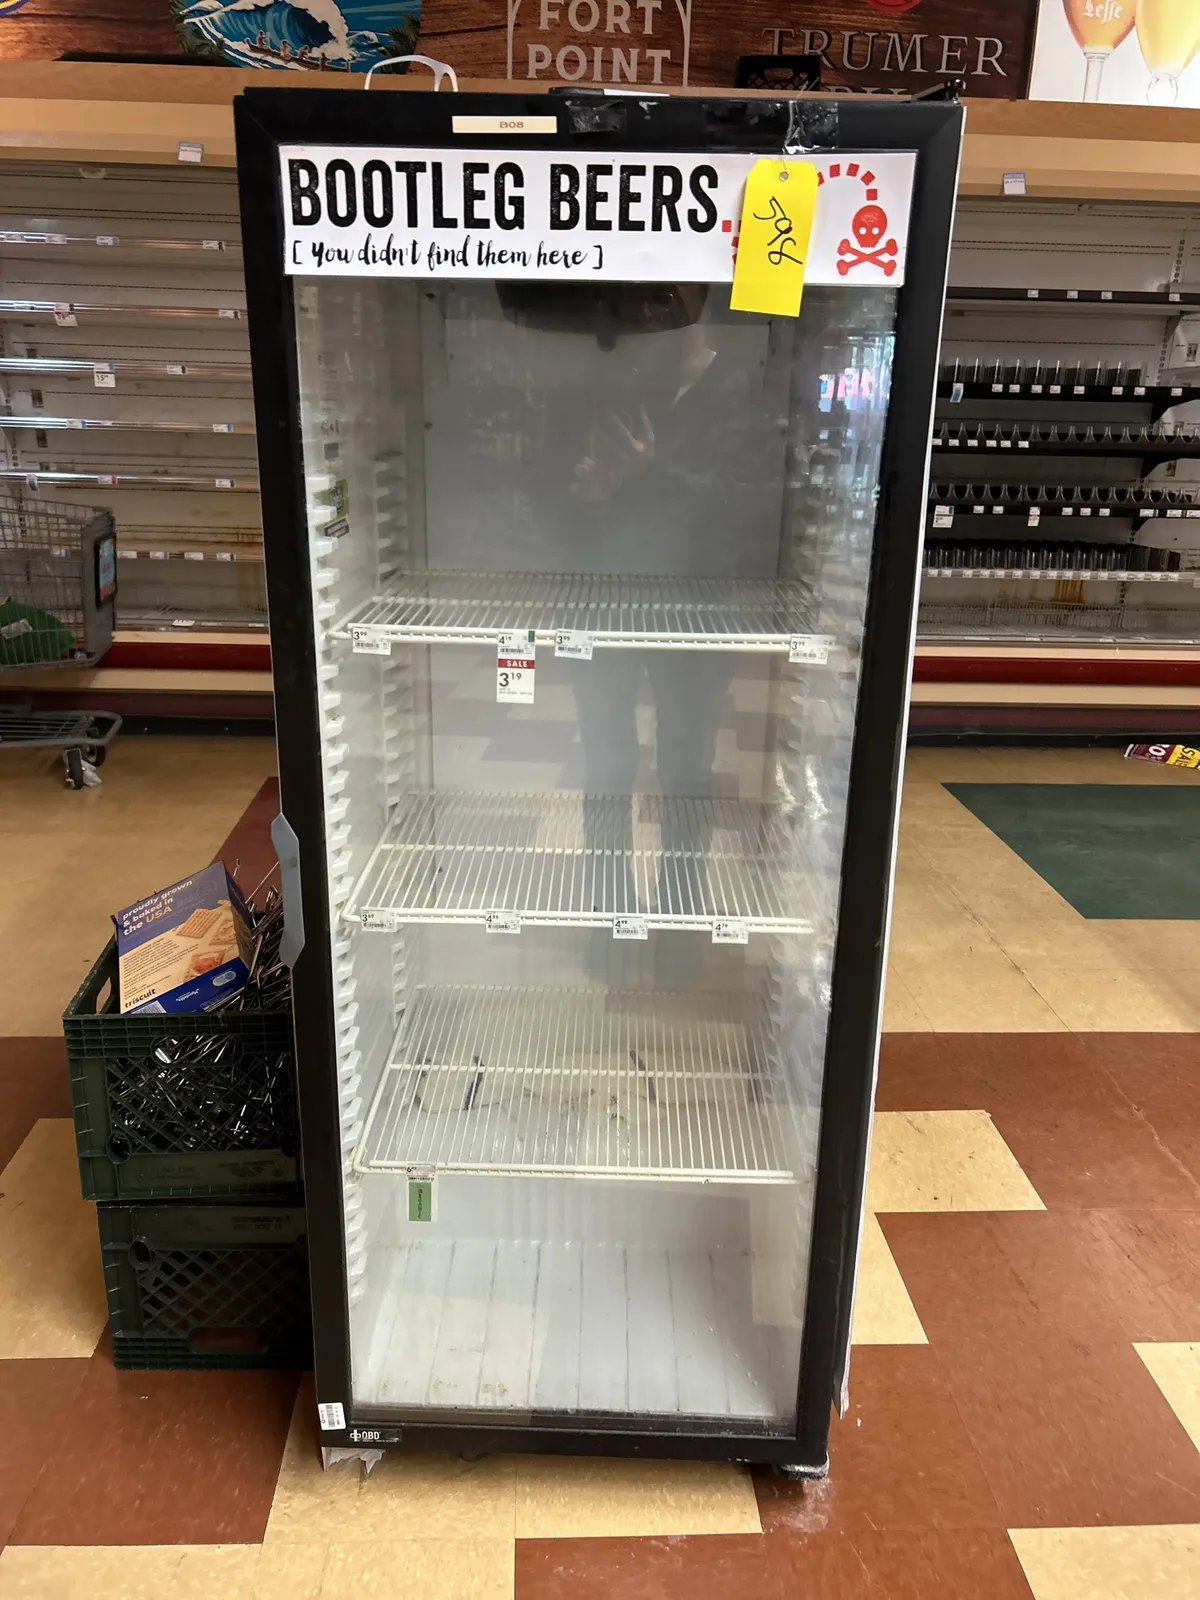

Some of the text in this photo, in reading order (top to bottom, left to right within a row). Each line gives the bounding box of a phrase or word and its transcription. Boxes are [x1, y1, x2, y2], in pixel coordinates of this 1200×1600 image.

[539, 0, 662, 34] FORT
[527, 44, 671, 84] POINT
[762, 27, 1008, 77] TRUMER
[288, 158, 525, 230] BOOTLEG
[358, 233, 421, 266] didn't
[427, 235, 471, 271] find
[476, 240, 532, 268] them
[536, 241, 588, 268] here
[506, 660, 528, 668] SALE
[122, 880, 193, 920] proudly grown
[132, 902, 162, 922] baked
[164, 897, 174, 906] in
[123, 906, 173, 936] the USA
[124, 988, 156, 1008] triscuit
